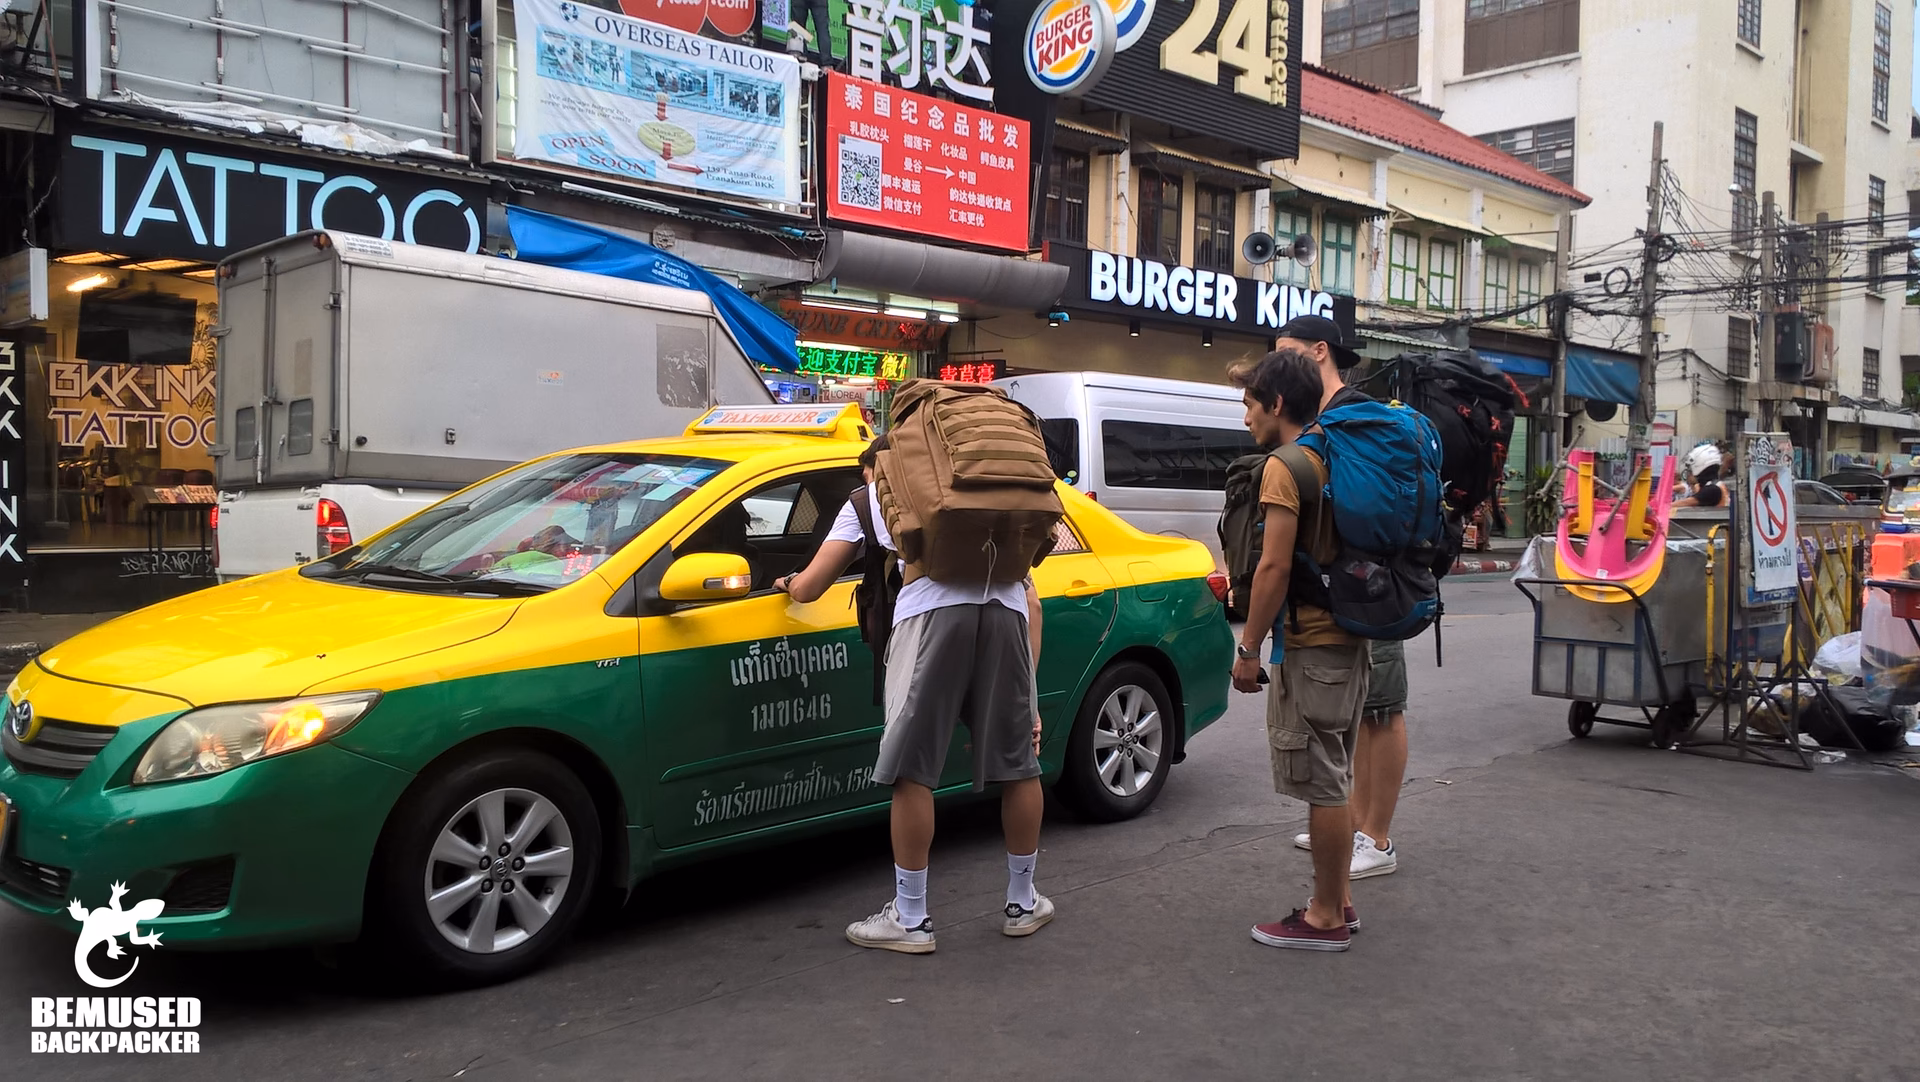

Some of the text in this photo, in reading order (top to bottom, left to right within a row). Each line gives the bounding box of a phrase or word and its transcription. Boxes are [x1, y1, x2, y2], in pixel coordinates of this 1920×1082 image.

[594, 15, 701, 57] OVERSEAS
[706, 45, 775, 75] TAILOR
[1036, 4, 1091, 50] BURGER
[846, 0, 995, 101] 韵达
[1038, 20, 1093, 73] KING
[1159, 0, 1272, 103] 24
[1270, 0, 1289, 107] HOURS
[844, 83, 1019, 149] 泰国纪念品批发
[849, 120, 890, 143] 乳胶枕头
[551, 135, 605, 150] OPEN
[940, 142, 968, 161] 化妆品
[980, 151, 1015, 171] 鳄鱼皮具
[589, 153, 647, 175] SOON
[903, 156, 977, 185] 曼谷 中国
[71, 134, 481, 255] TATTOO
[754, 180, 775, 189] BKK
[881, 172, 922, 195] 顺丰速运
[883, 195, 922, 216] 微信支付
[948, 208, 985, 228] 汇率更优
[1090, 249, 1335, 328] BURGER KING
[49, 361, 216, 408] BKK INK
[718, 411, 819, 424] TAXI-METER
[1758, 547, 1792, 570] ห้ามตรงไป
[730, 635, 848, 689] แท็กซี่บุคคล
